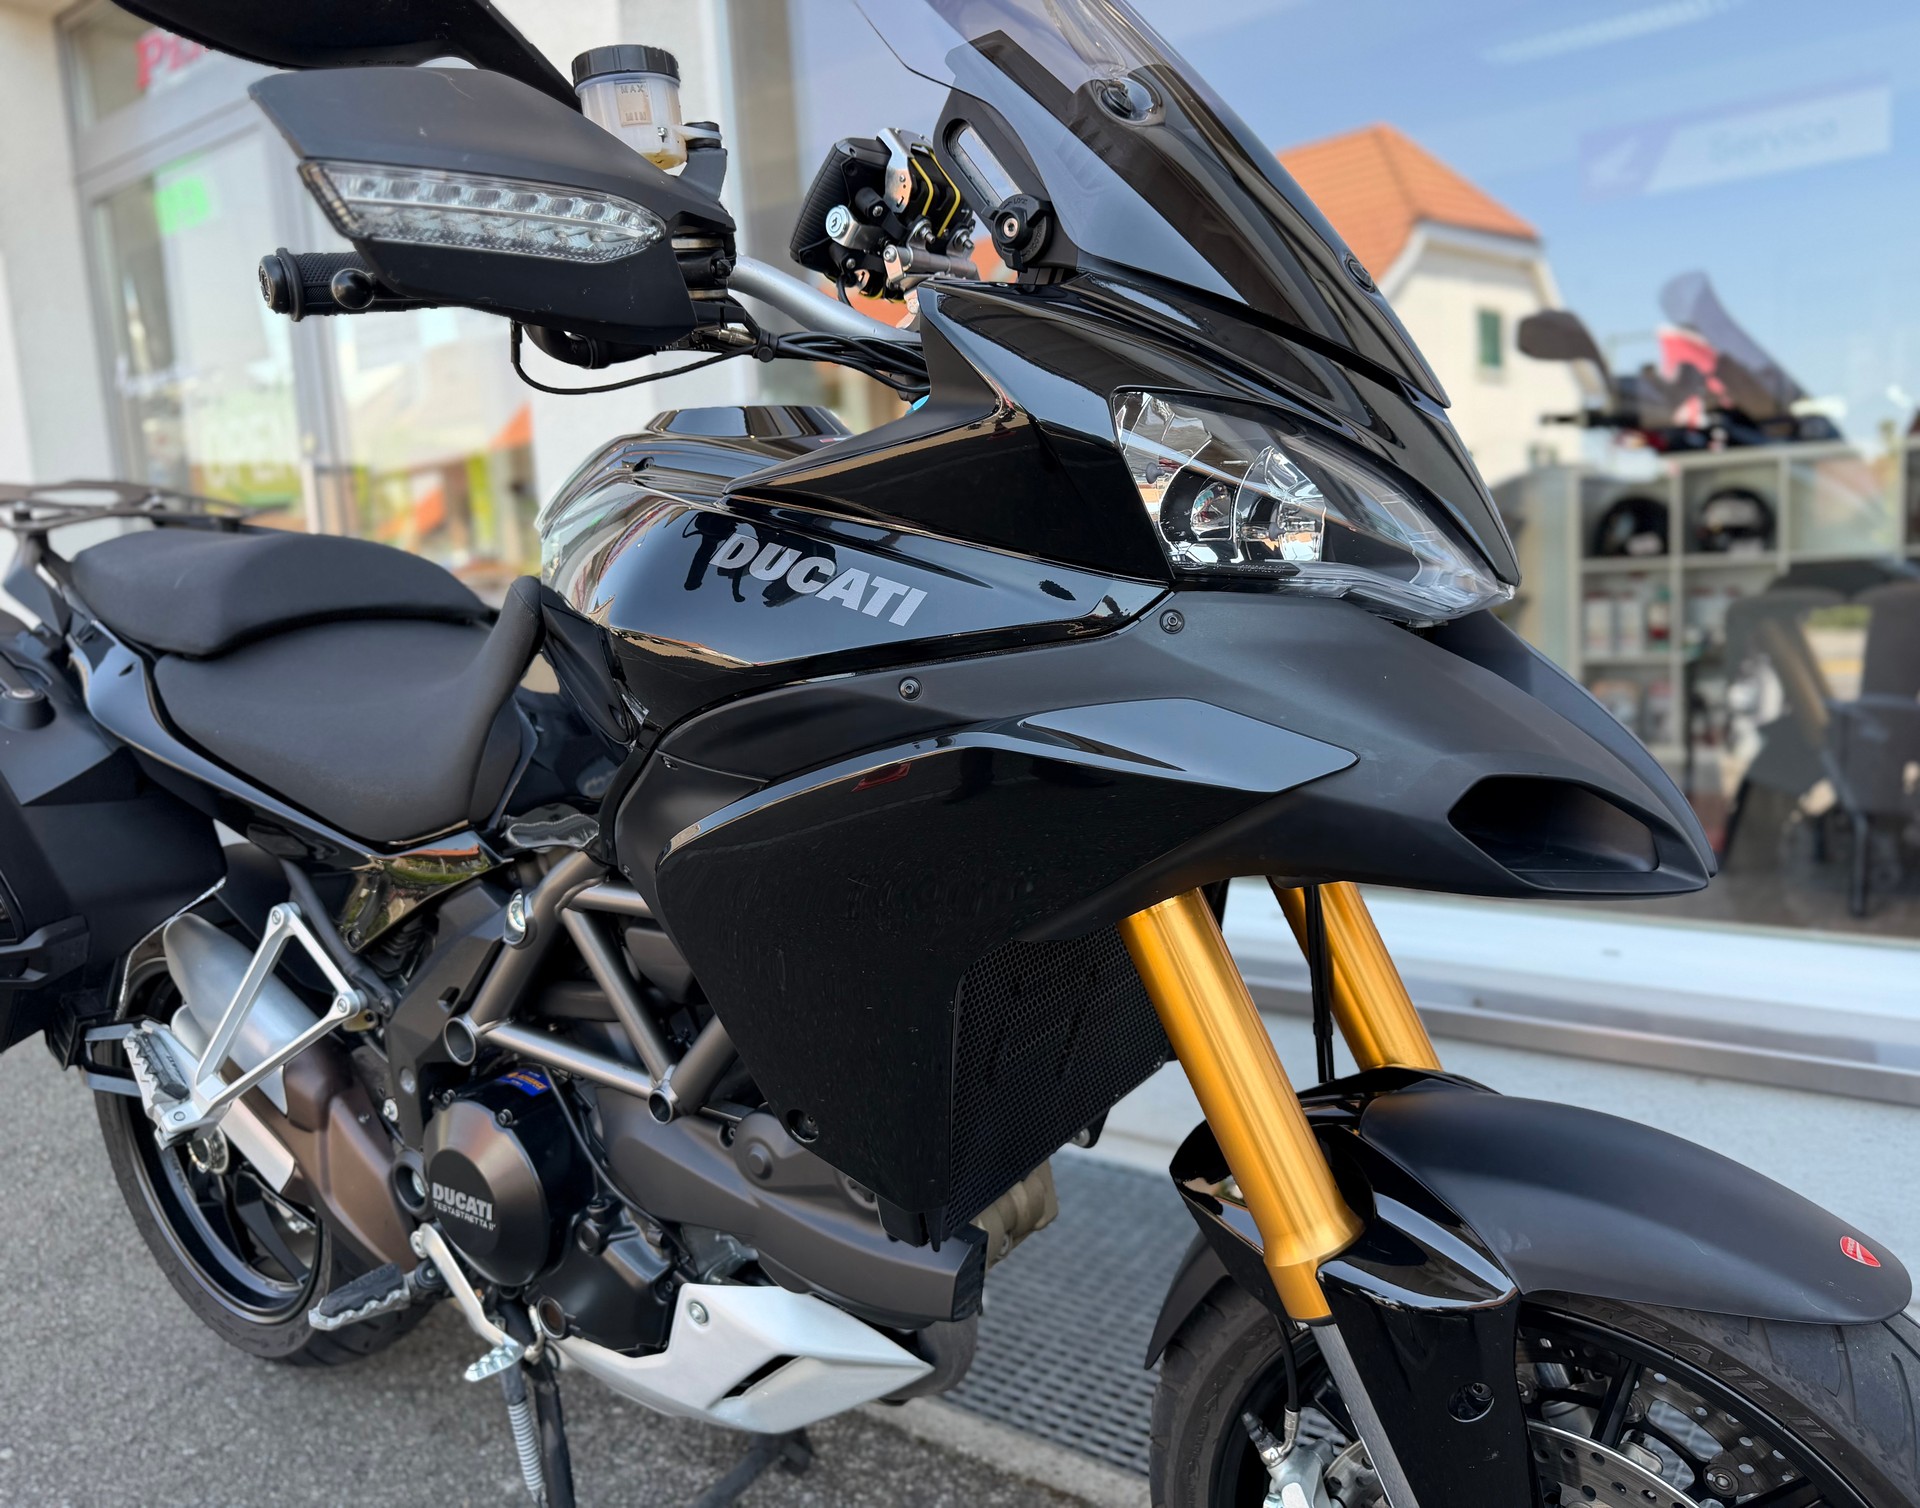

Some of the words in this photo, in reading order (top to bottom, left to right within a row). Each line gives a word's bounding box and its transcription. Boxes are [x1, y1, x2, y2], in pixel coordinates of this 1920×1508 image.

[619, 84, 645, 94] MAX
[624, 111, 647, 121] MIN
[709, 532, 928, 627] DUCATI
[432, 1182, 493, 1221] DUCATI
[433, 1200, 488, 1229] TESTASTRETTA
